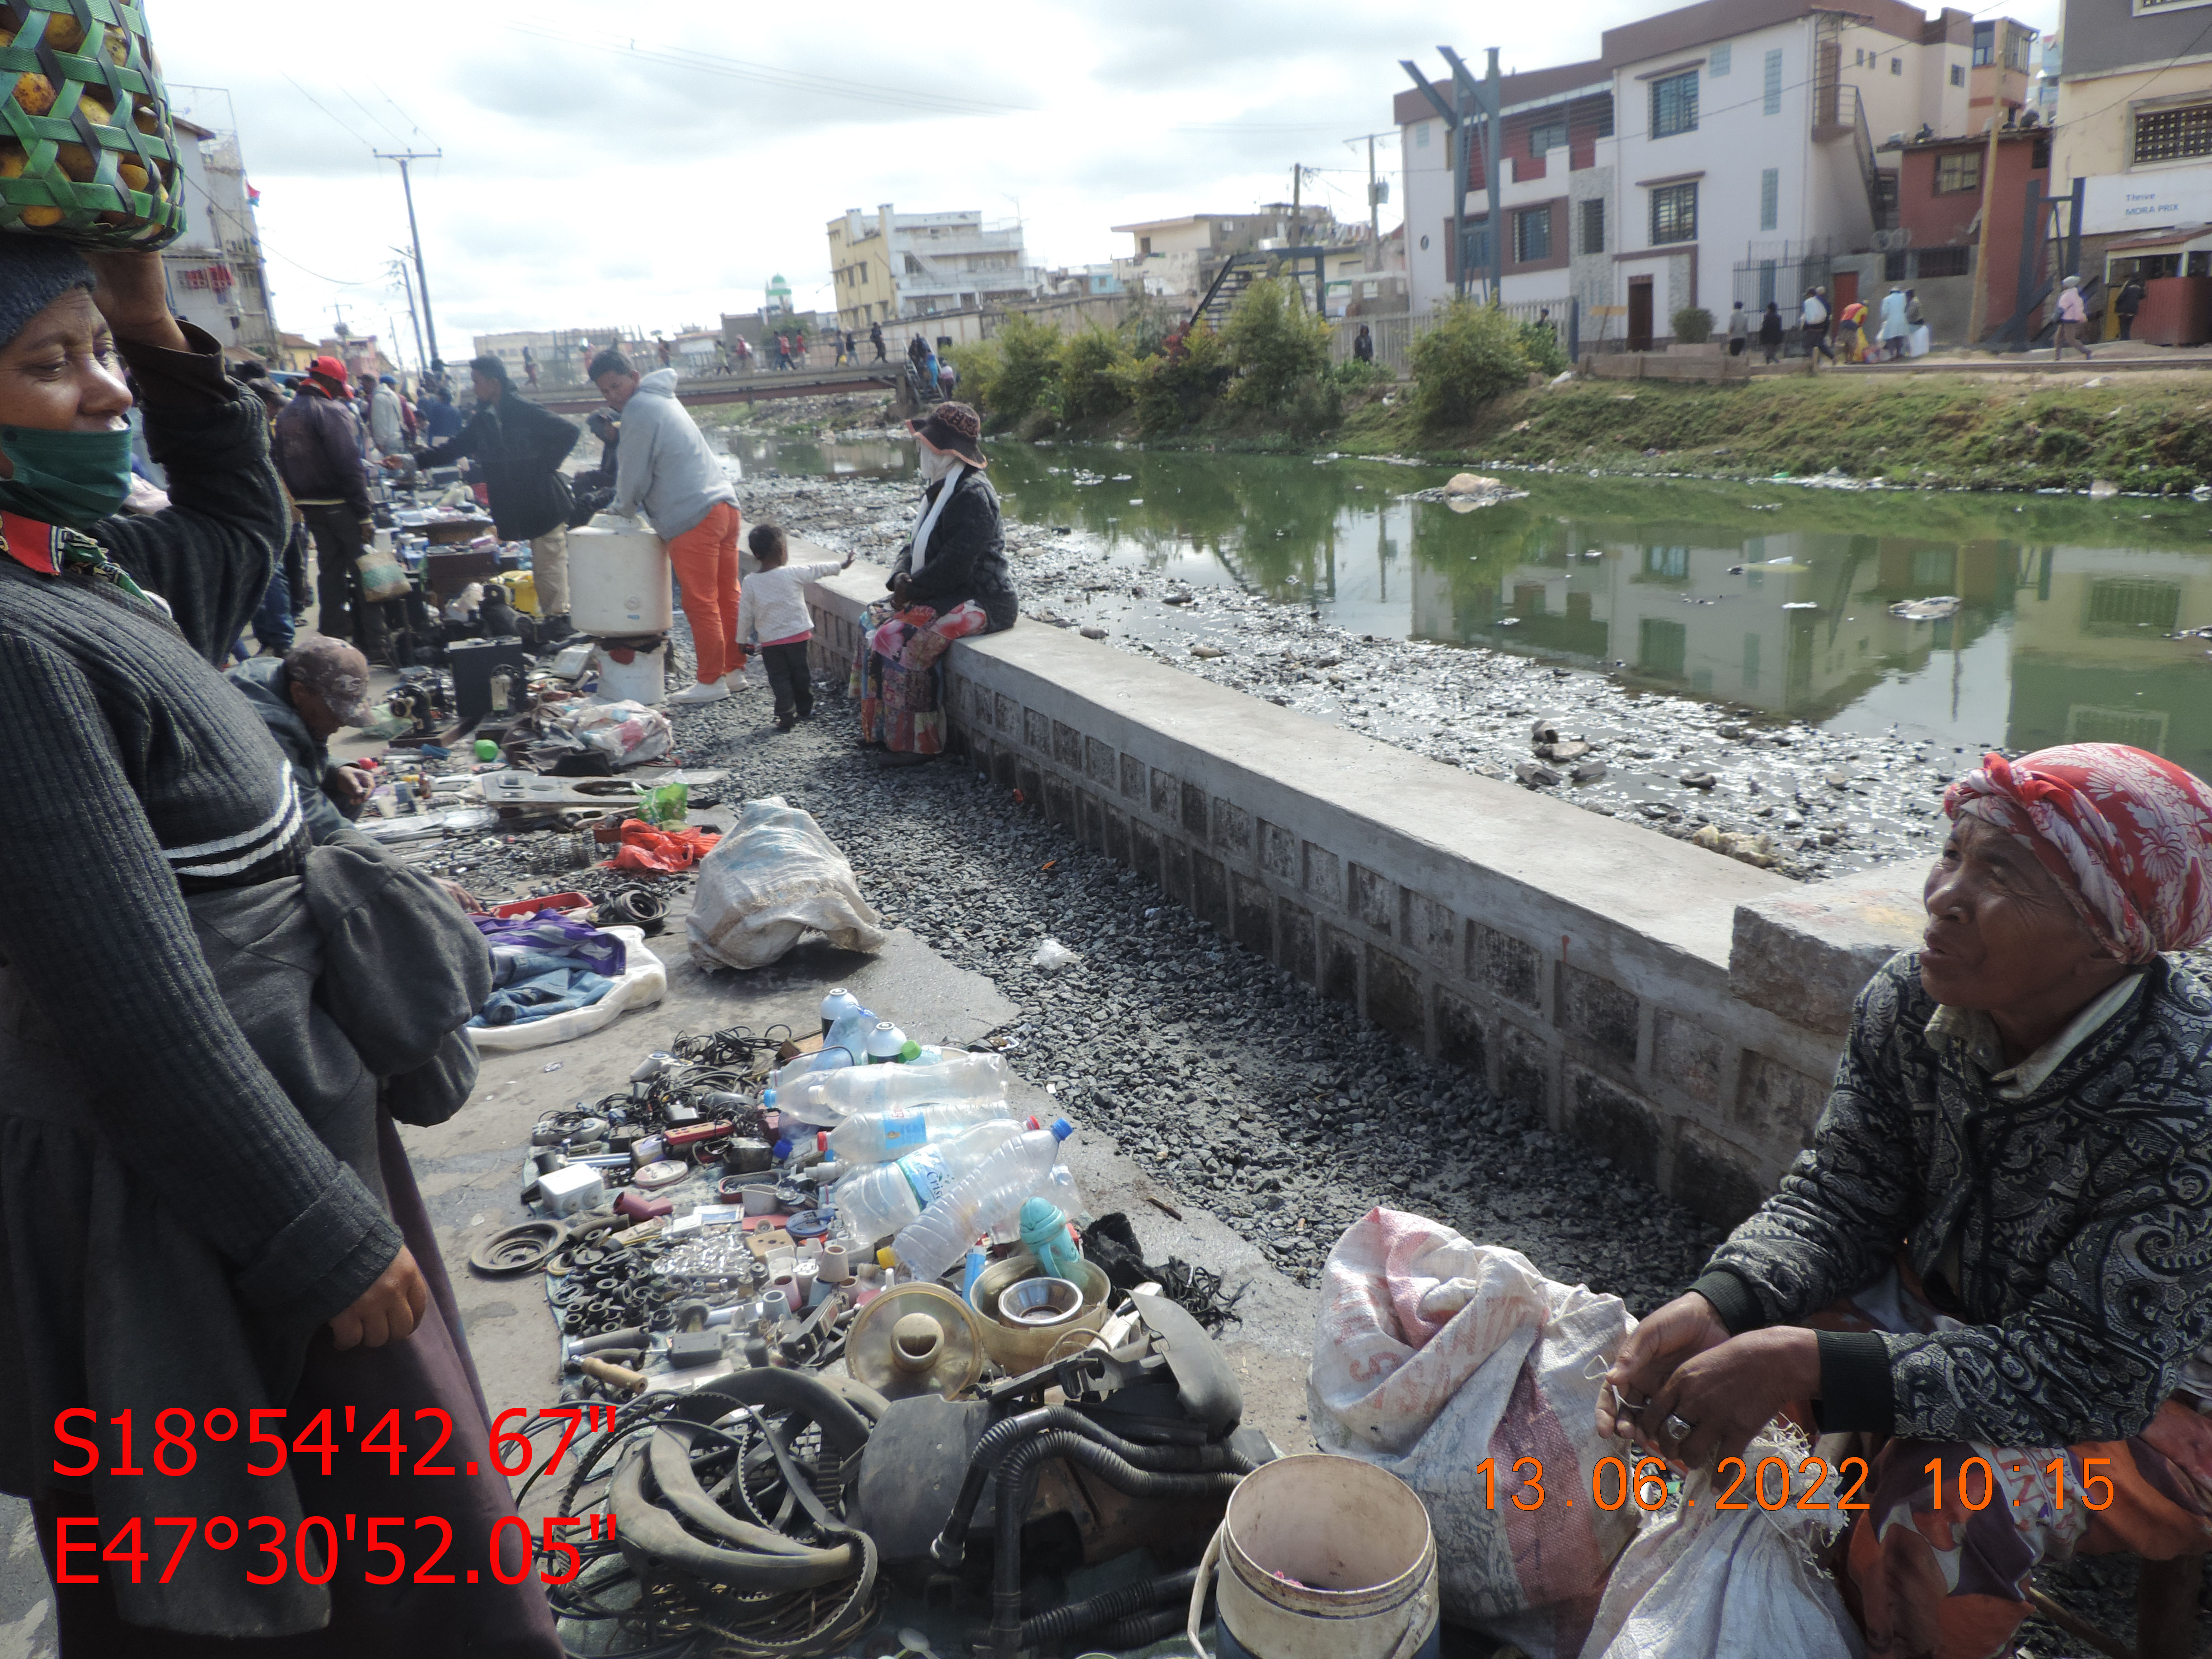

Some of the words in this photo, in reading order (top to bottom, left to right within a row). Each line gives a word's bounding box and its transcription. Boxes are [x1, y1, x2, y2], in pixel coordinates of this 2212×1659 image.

[2126, 193, 2156, 202] Thrive
[2125, 206, 2156, 215] MORA
[2158, 203, 2179, 212] PRIX
